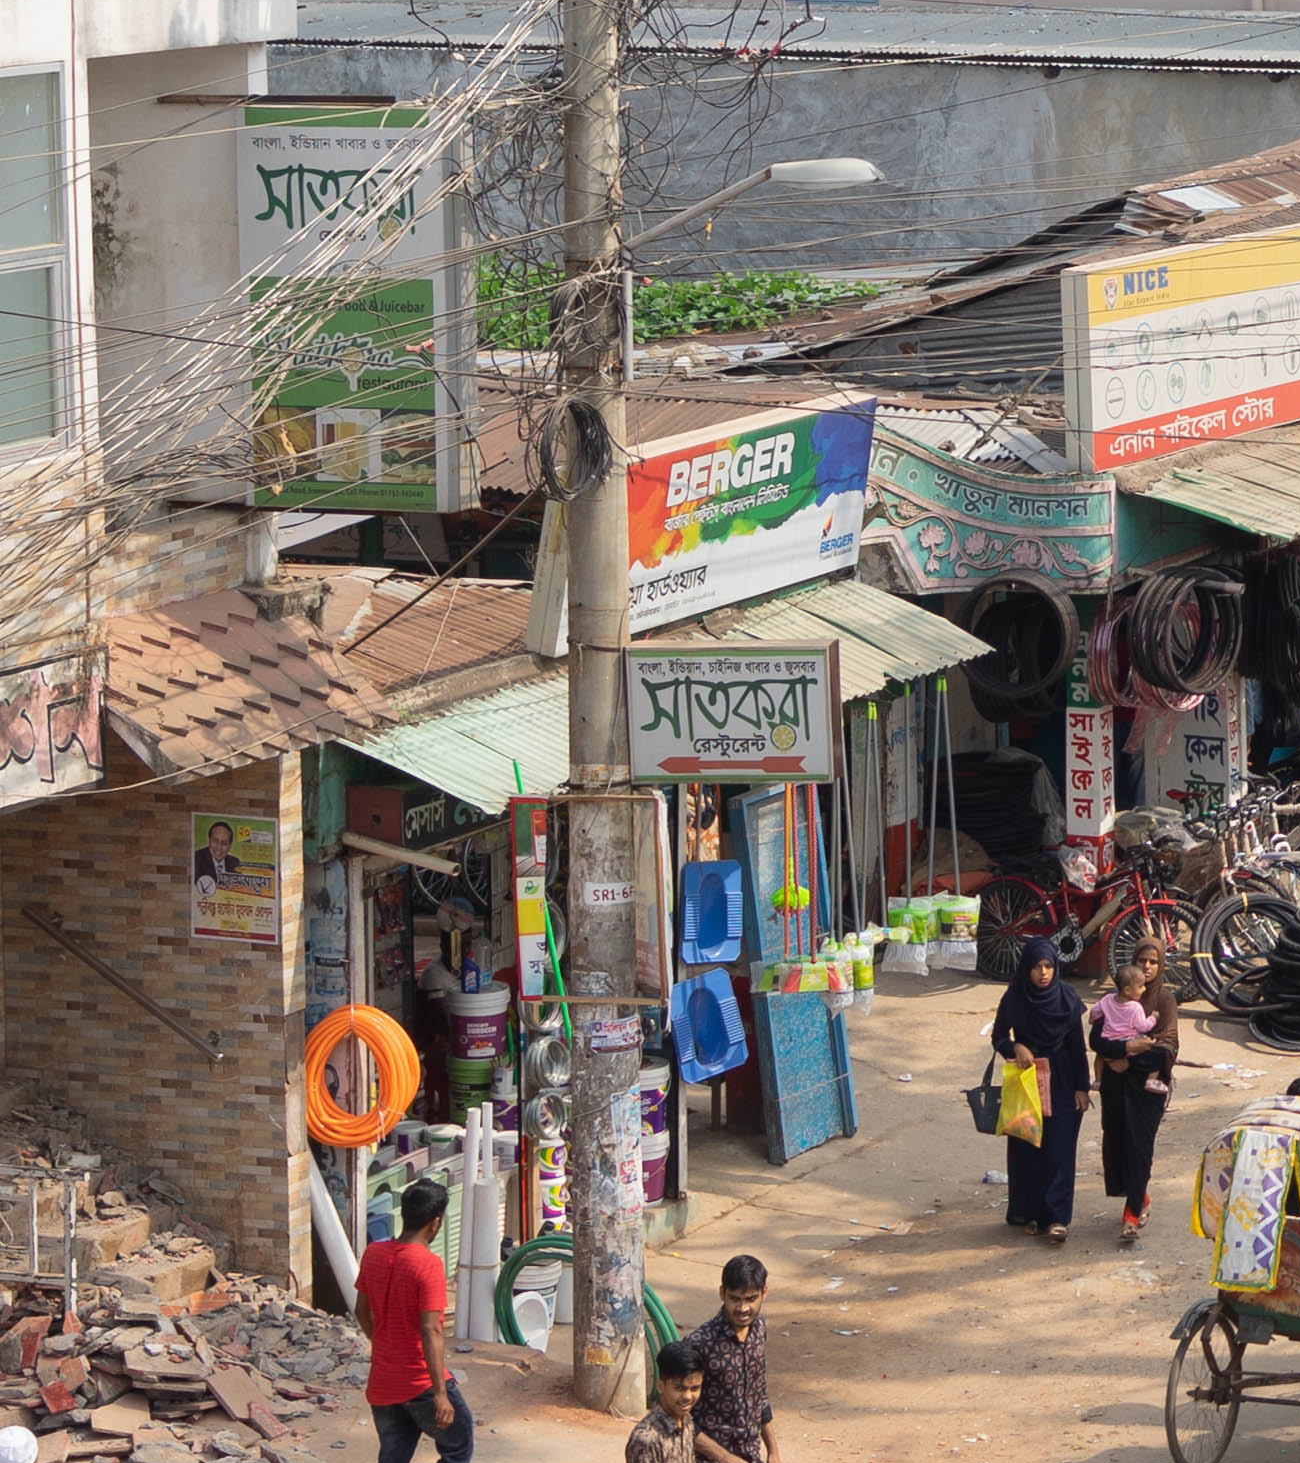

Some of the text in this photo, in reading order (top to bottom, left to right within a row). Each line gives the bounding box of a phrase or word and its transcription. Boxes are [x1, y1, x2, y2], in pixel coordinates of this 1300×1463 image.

[252, 133, 382, 151] বাংলা, ইন্ডিয়ান খাবার ও
[1122, 266, 1169, 296] NICE
[380, 299, 425, 314] Juicebar
[357, 378, 428, 391] restaurant
[1109, 395, 1274, 458] এনাম সাইকেল স্টোর
[665, 432, 797, 508] BERGER
[934, 473, 1090, 519] খাতুন ম্যানশন
[819, 532, 854, 554] BERGER
[638, 658, 816, 676] বাংলা, ইন্ডিয়ান, চাইনিজ খাবার ও জুসবার
[640, 675, 818, 741] সাতকরা
[693, 733, 767, 758] রেস্টুরেন্ট
[405, 792, 448, 844] মেসার্স
